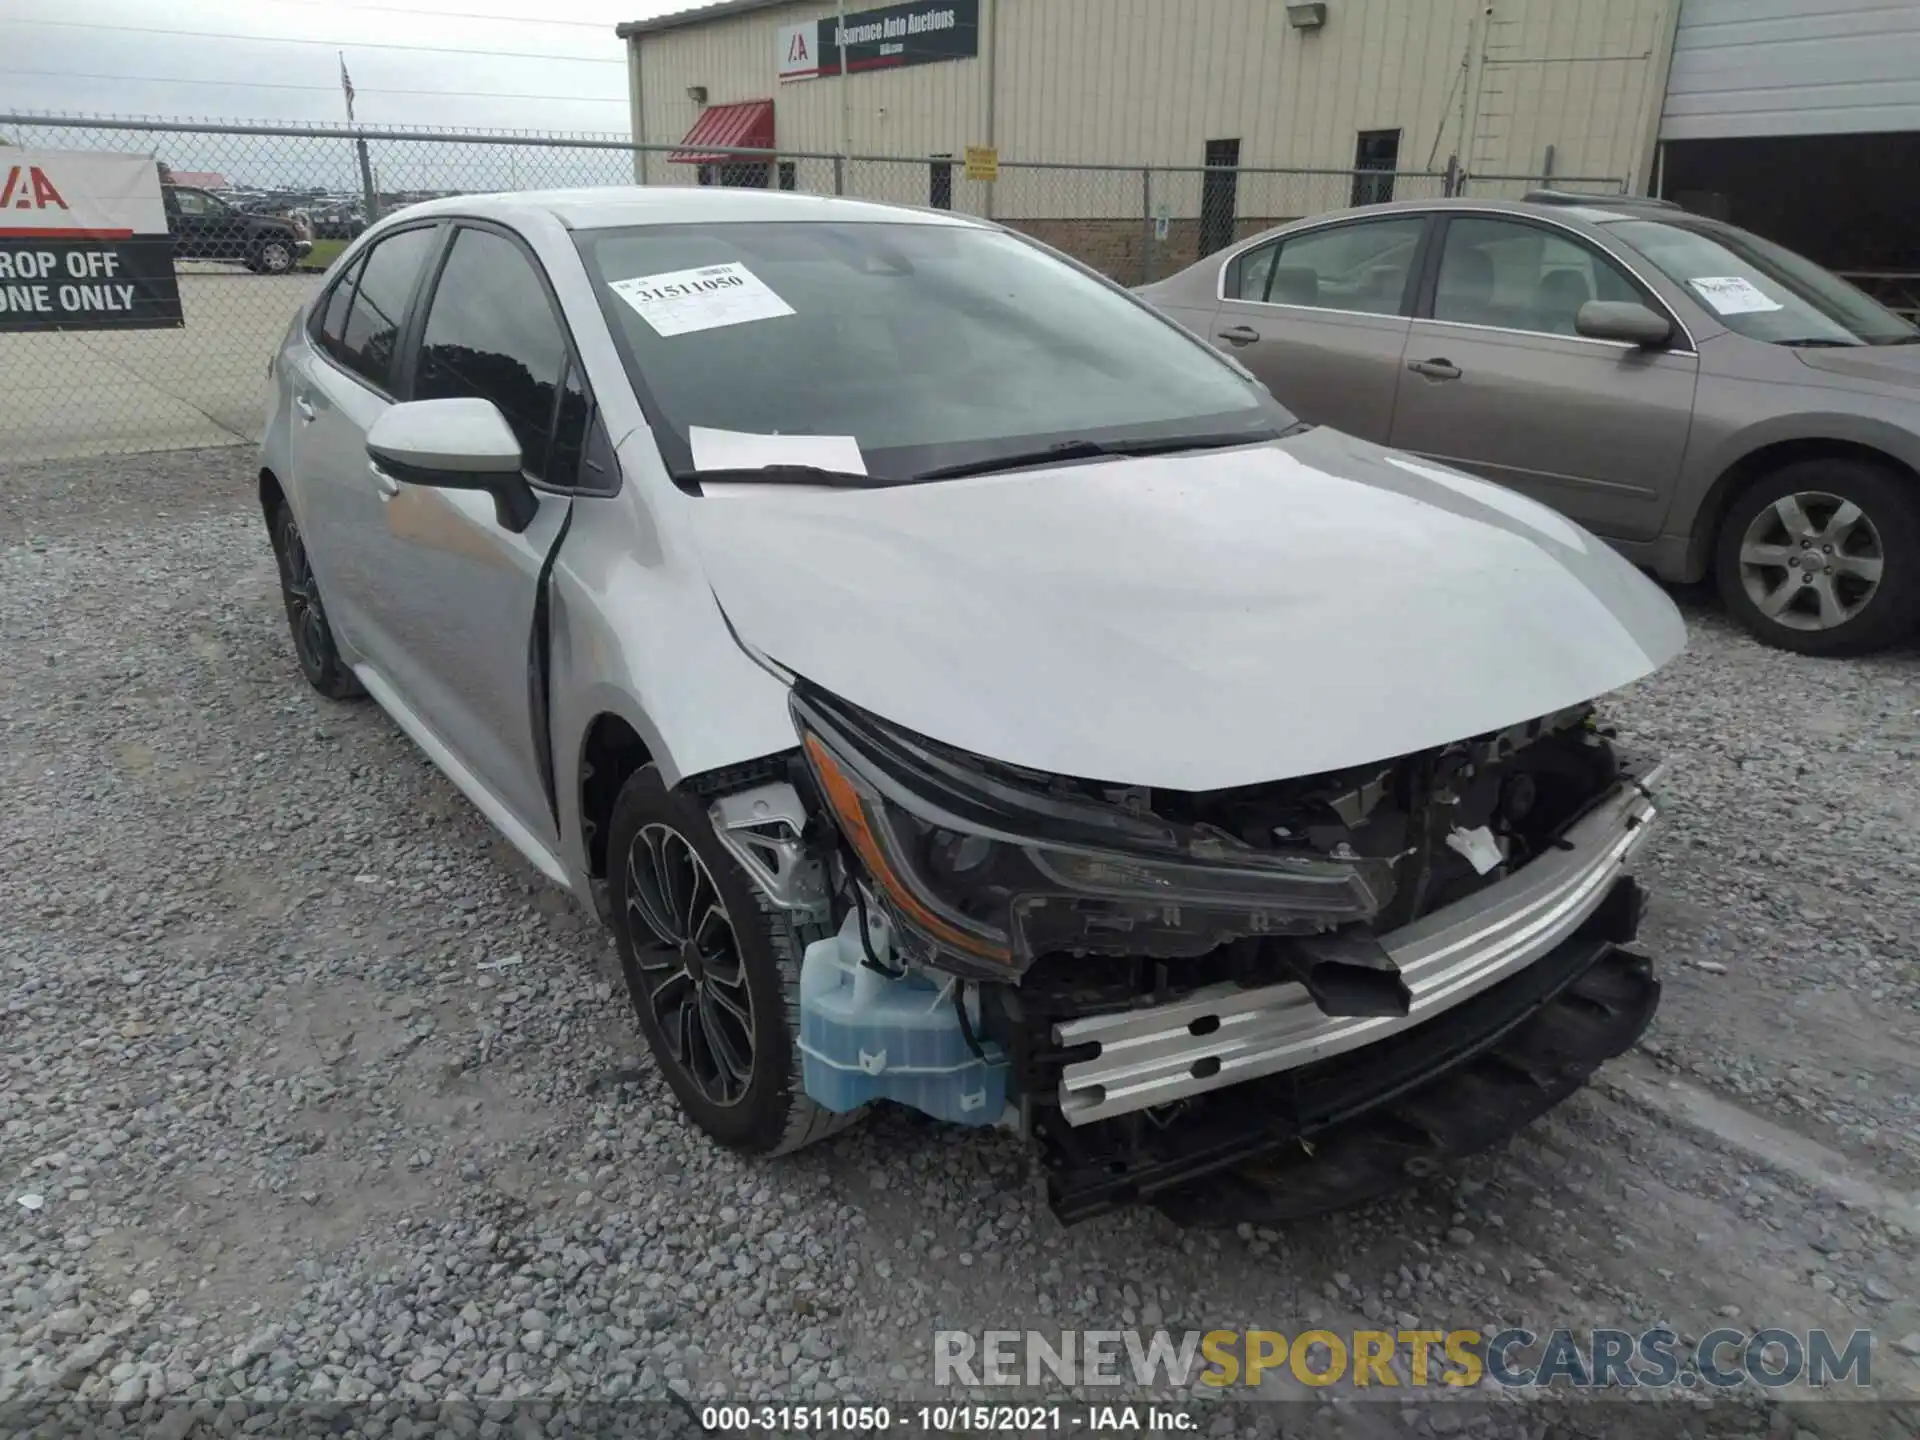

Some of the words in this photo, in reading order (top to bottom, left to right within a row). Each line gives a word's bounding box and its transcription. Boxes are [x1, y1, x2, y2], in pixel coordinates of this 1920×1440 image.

[835, 23, 882, 46] Isurance
[883, 17, 906, 38] Auto
[907, 9, 955, 34] Auctions
[66, 252, 119, 278] OFF
[59, 285, 135, 311] ONLY
[636, 275, 744, 302] 31511050
